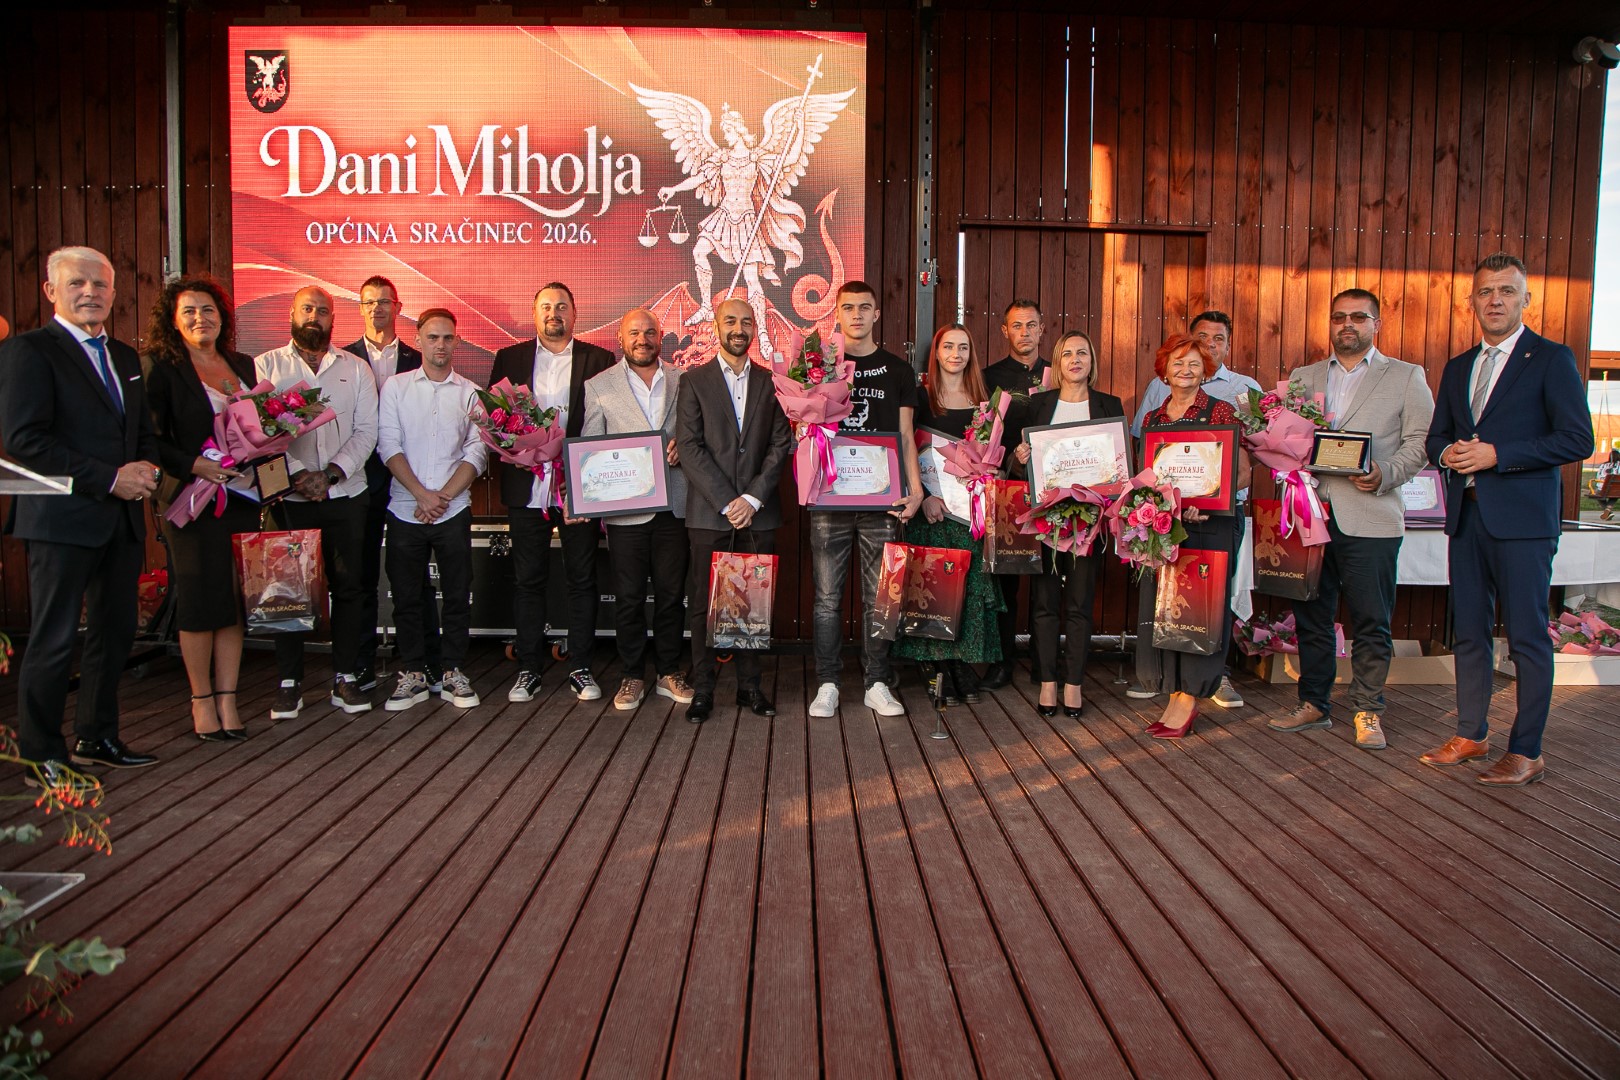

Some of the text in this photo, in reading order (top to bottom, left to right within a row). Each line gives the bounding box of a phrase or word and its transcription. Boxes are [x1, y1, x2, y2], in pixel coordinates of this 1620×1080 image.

[259, 124, 644, 218] Dani Miholja
[306, 216, 597, 244] OPĆINA SRAČINEC 2026.
[863, 365, 888, 378] FIGHT
[858, 387, 885, 399] CLUB
[1060, 457, 1099, 468] PRIZNANJE
[598, 469, 637, 479] PRIZNANJE
[837, 466, 873, 474] PRIZNANJE
[1168, 466, 1205, 474] PRIZNANJE
[1258, 569, 1305, 579] OPĆINA SRAČINEC
[1180, 624, 1207, 633] SRAČINEC
